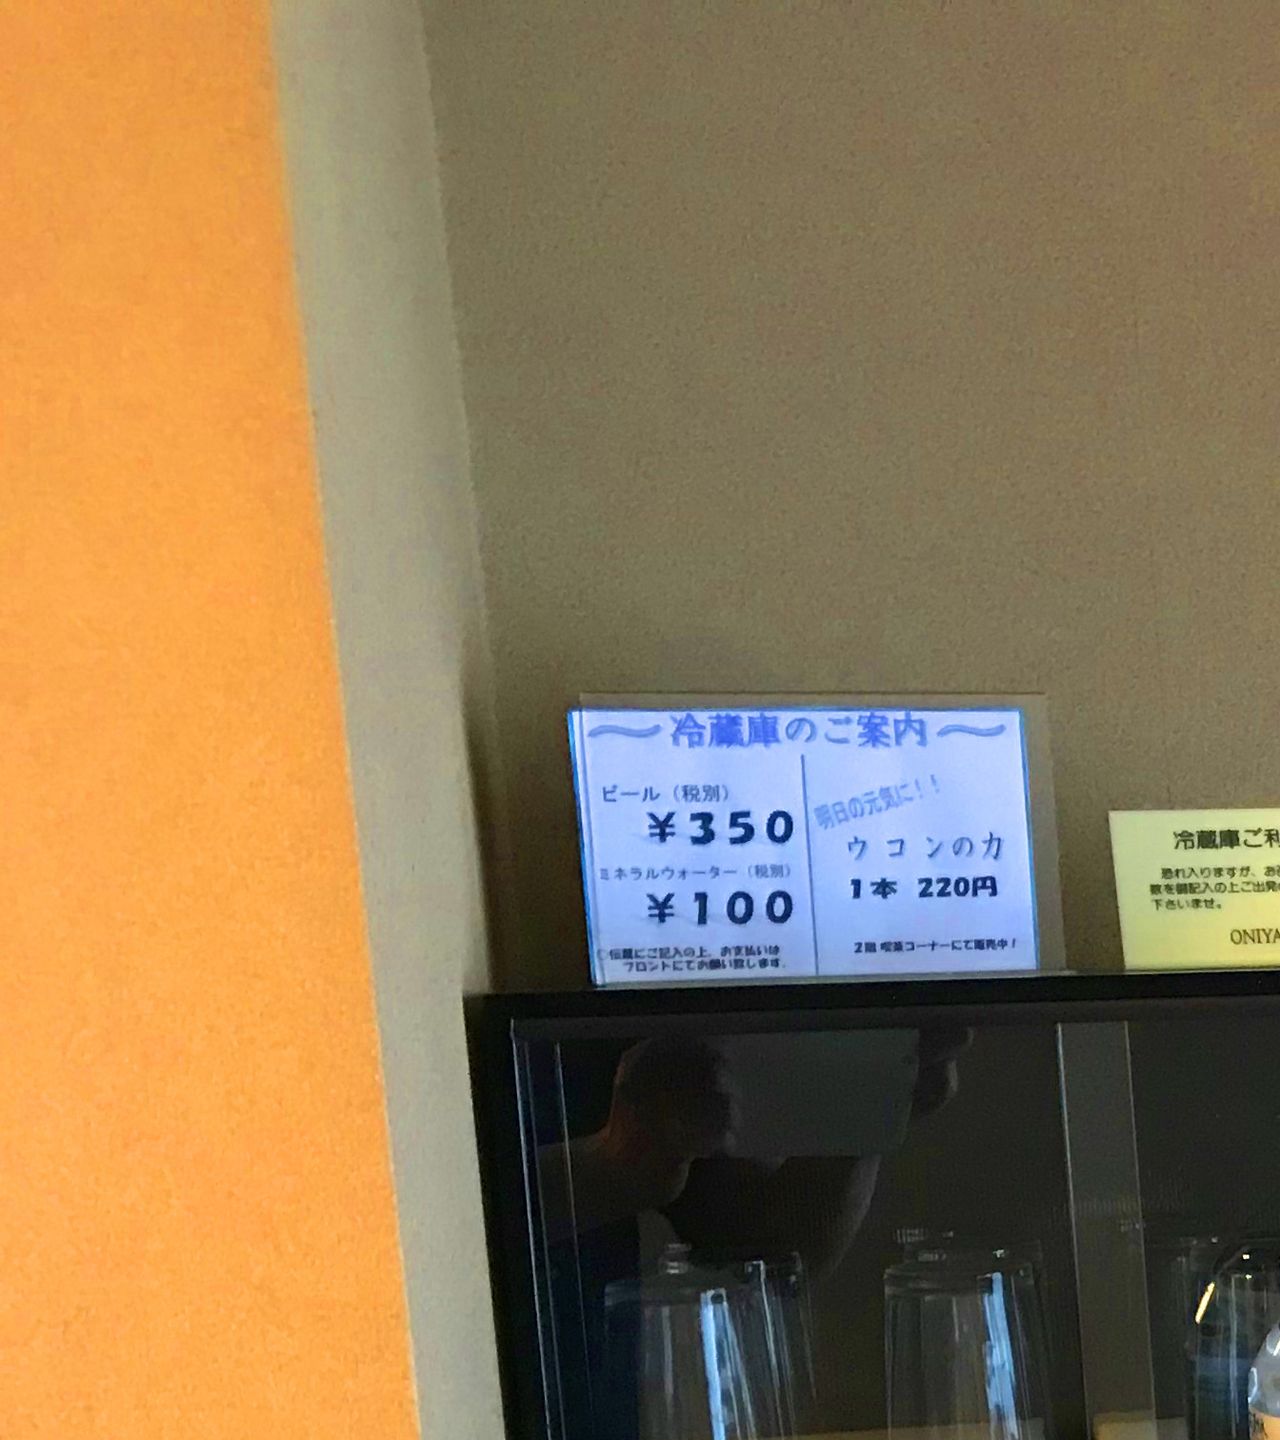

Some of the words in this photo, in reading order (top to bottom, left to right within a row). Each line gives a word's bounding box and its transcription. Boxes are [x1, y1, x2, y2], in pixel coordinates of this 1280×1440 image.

[671, 713, 927, 748] 冷蔵庫のご案内
[848, 832, 1003, 860] ウコンの力
[918, 875, 998, 898] 220円
[1152, 897, 1223, 912] 下さいませ。
